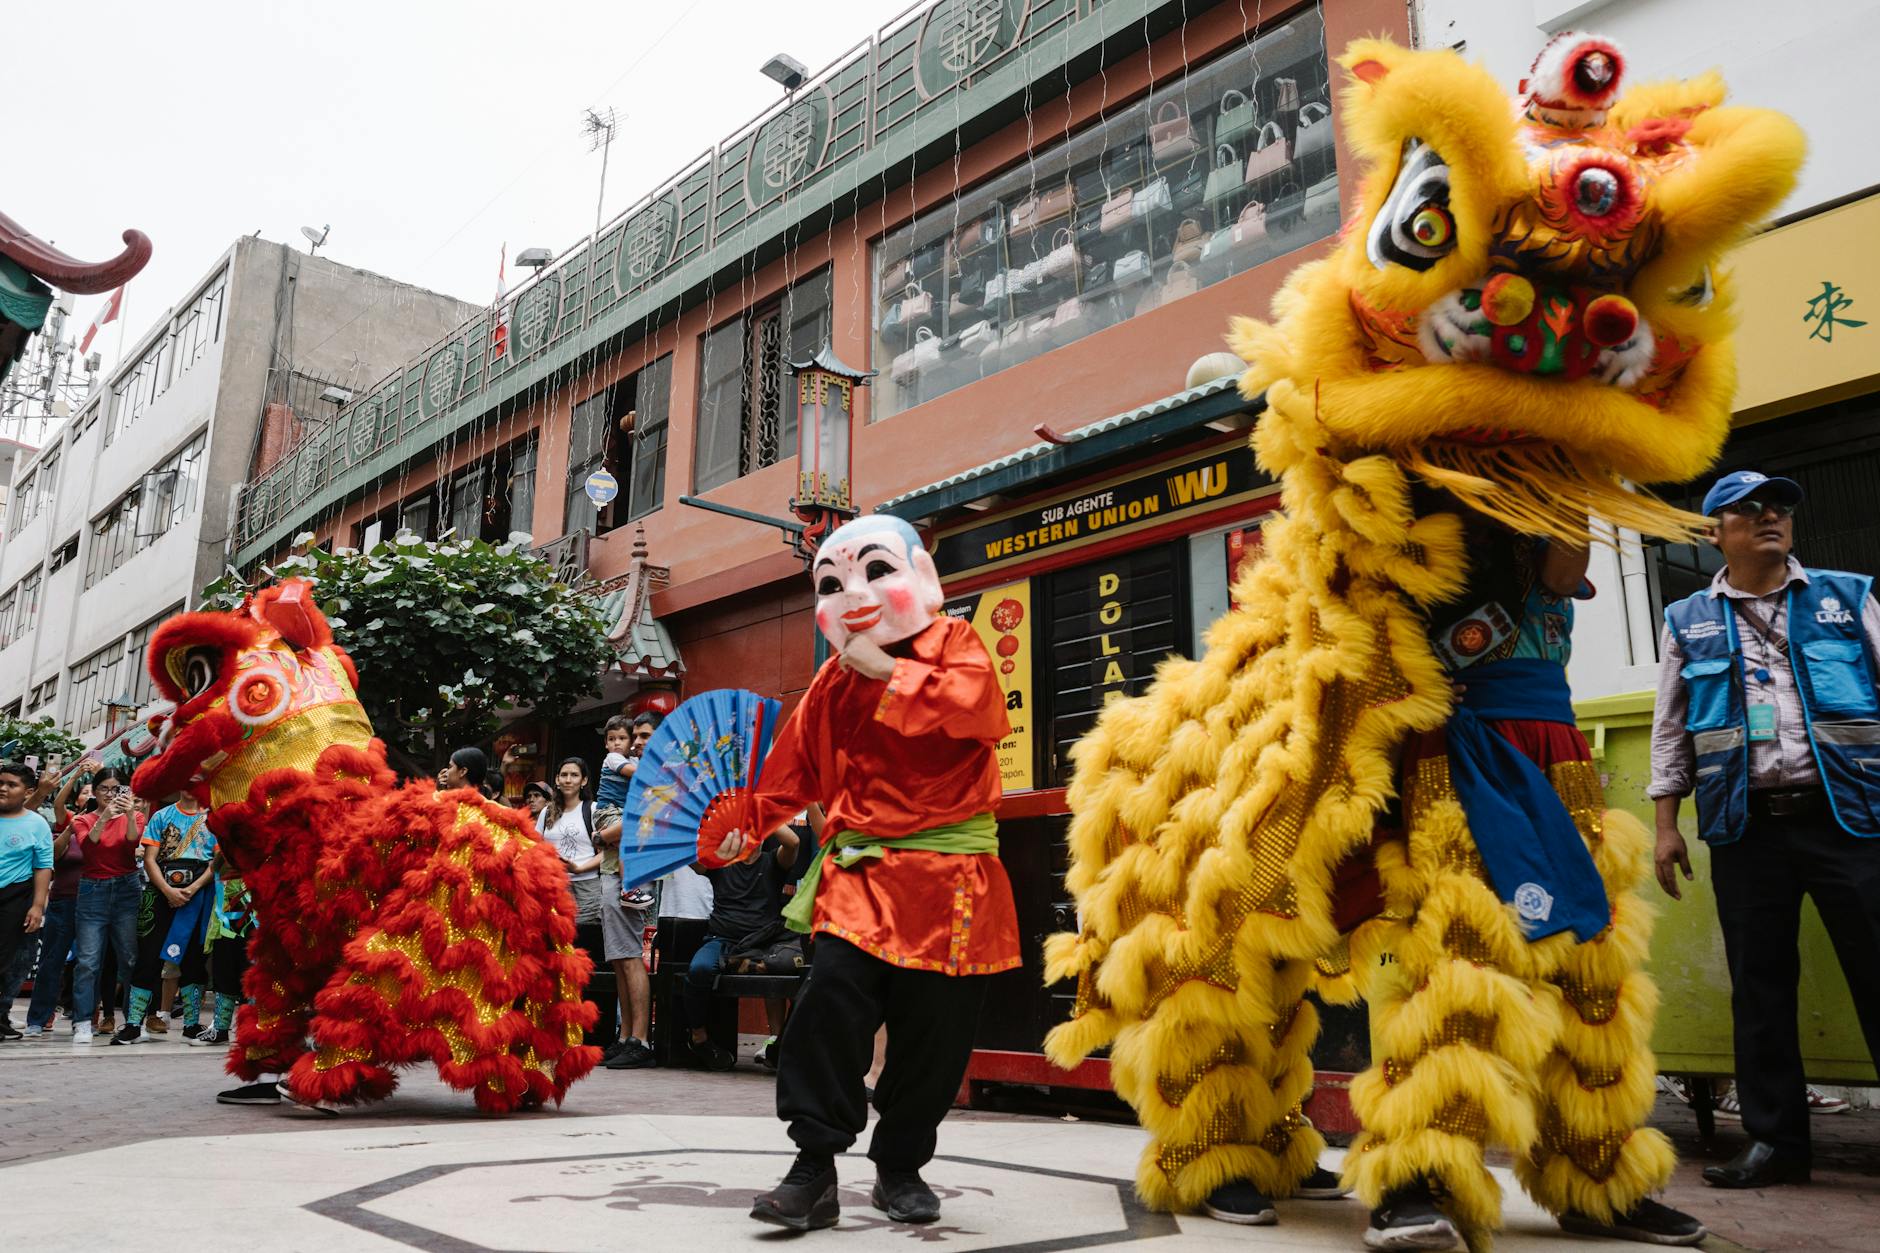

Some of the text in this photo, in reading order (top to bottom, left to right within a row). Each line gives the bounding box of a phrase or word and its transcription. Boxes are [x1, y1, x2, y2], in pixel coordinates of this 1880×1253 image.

[1167, 462, 1228, 507] WU
[985, 494, 1160, 560] WESTERN UNION
[1041, 491, 1114, 525] SUB AGENTE
[1002, 741, 1016, 749] en:
